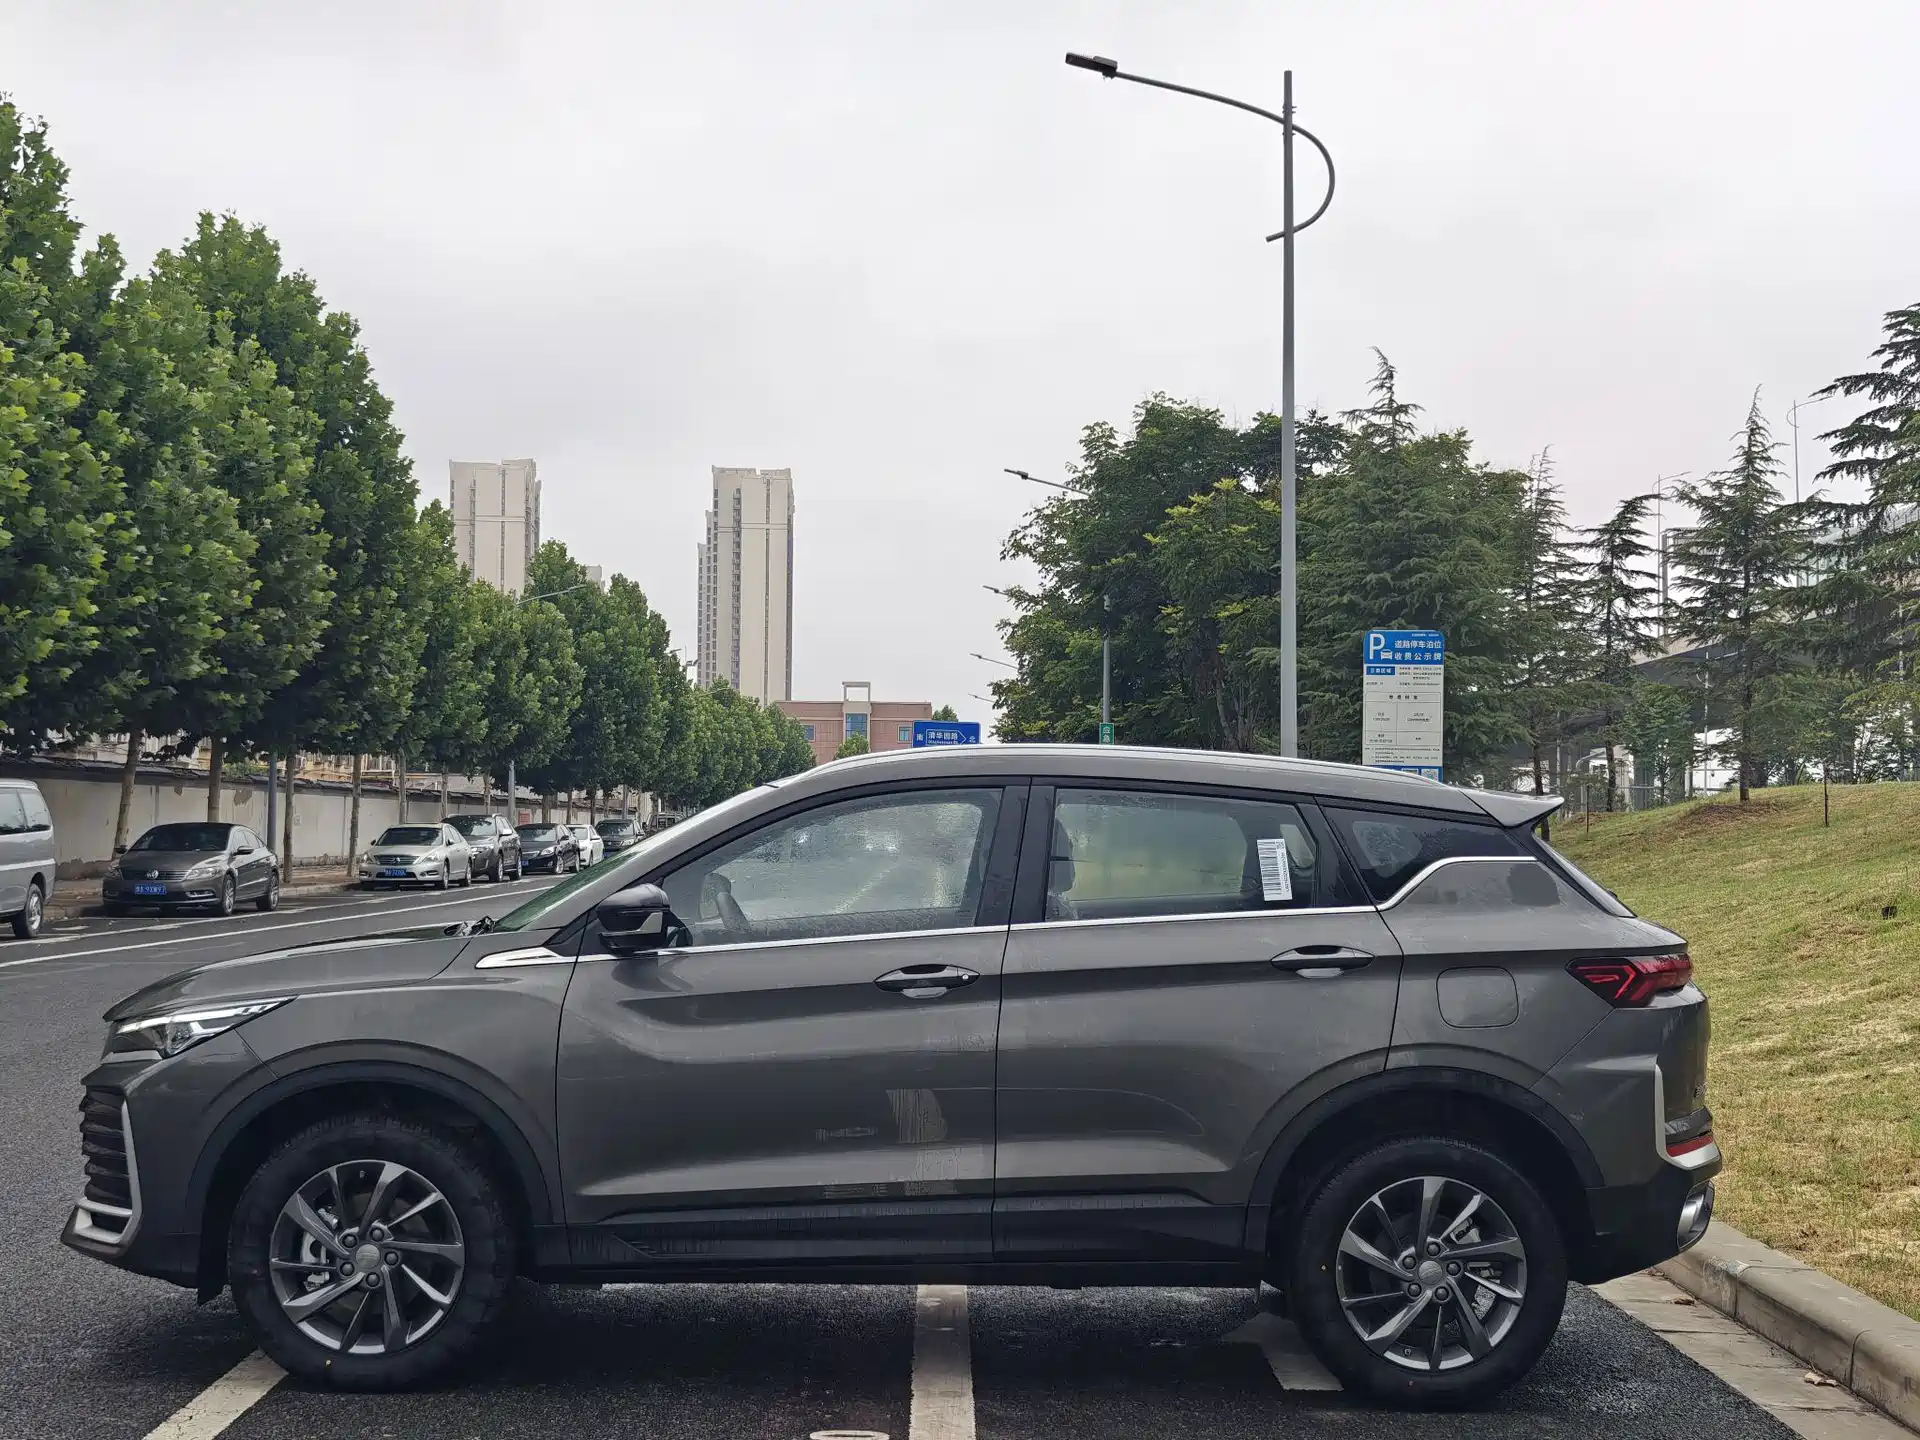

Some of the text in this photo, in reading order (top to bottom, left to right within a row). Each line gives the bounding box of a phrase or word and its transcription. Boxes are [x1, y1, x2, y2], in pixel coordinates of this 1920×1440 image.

[1369, 633, 1385, 660] P
[1394, 640, 1442, 649] 道路停车泊位
[1394, 652, 1442, 661] 收费公示牌
[916, 733, 924, 741] 南
[928, 731, 958, 740] 清华园路
[969, 735, 976, 743] 北
[1102, 726, 1111, 743] 应急
